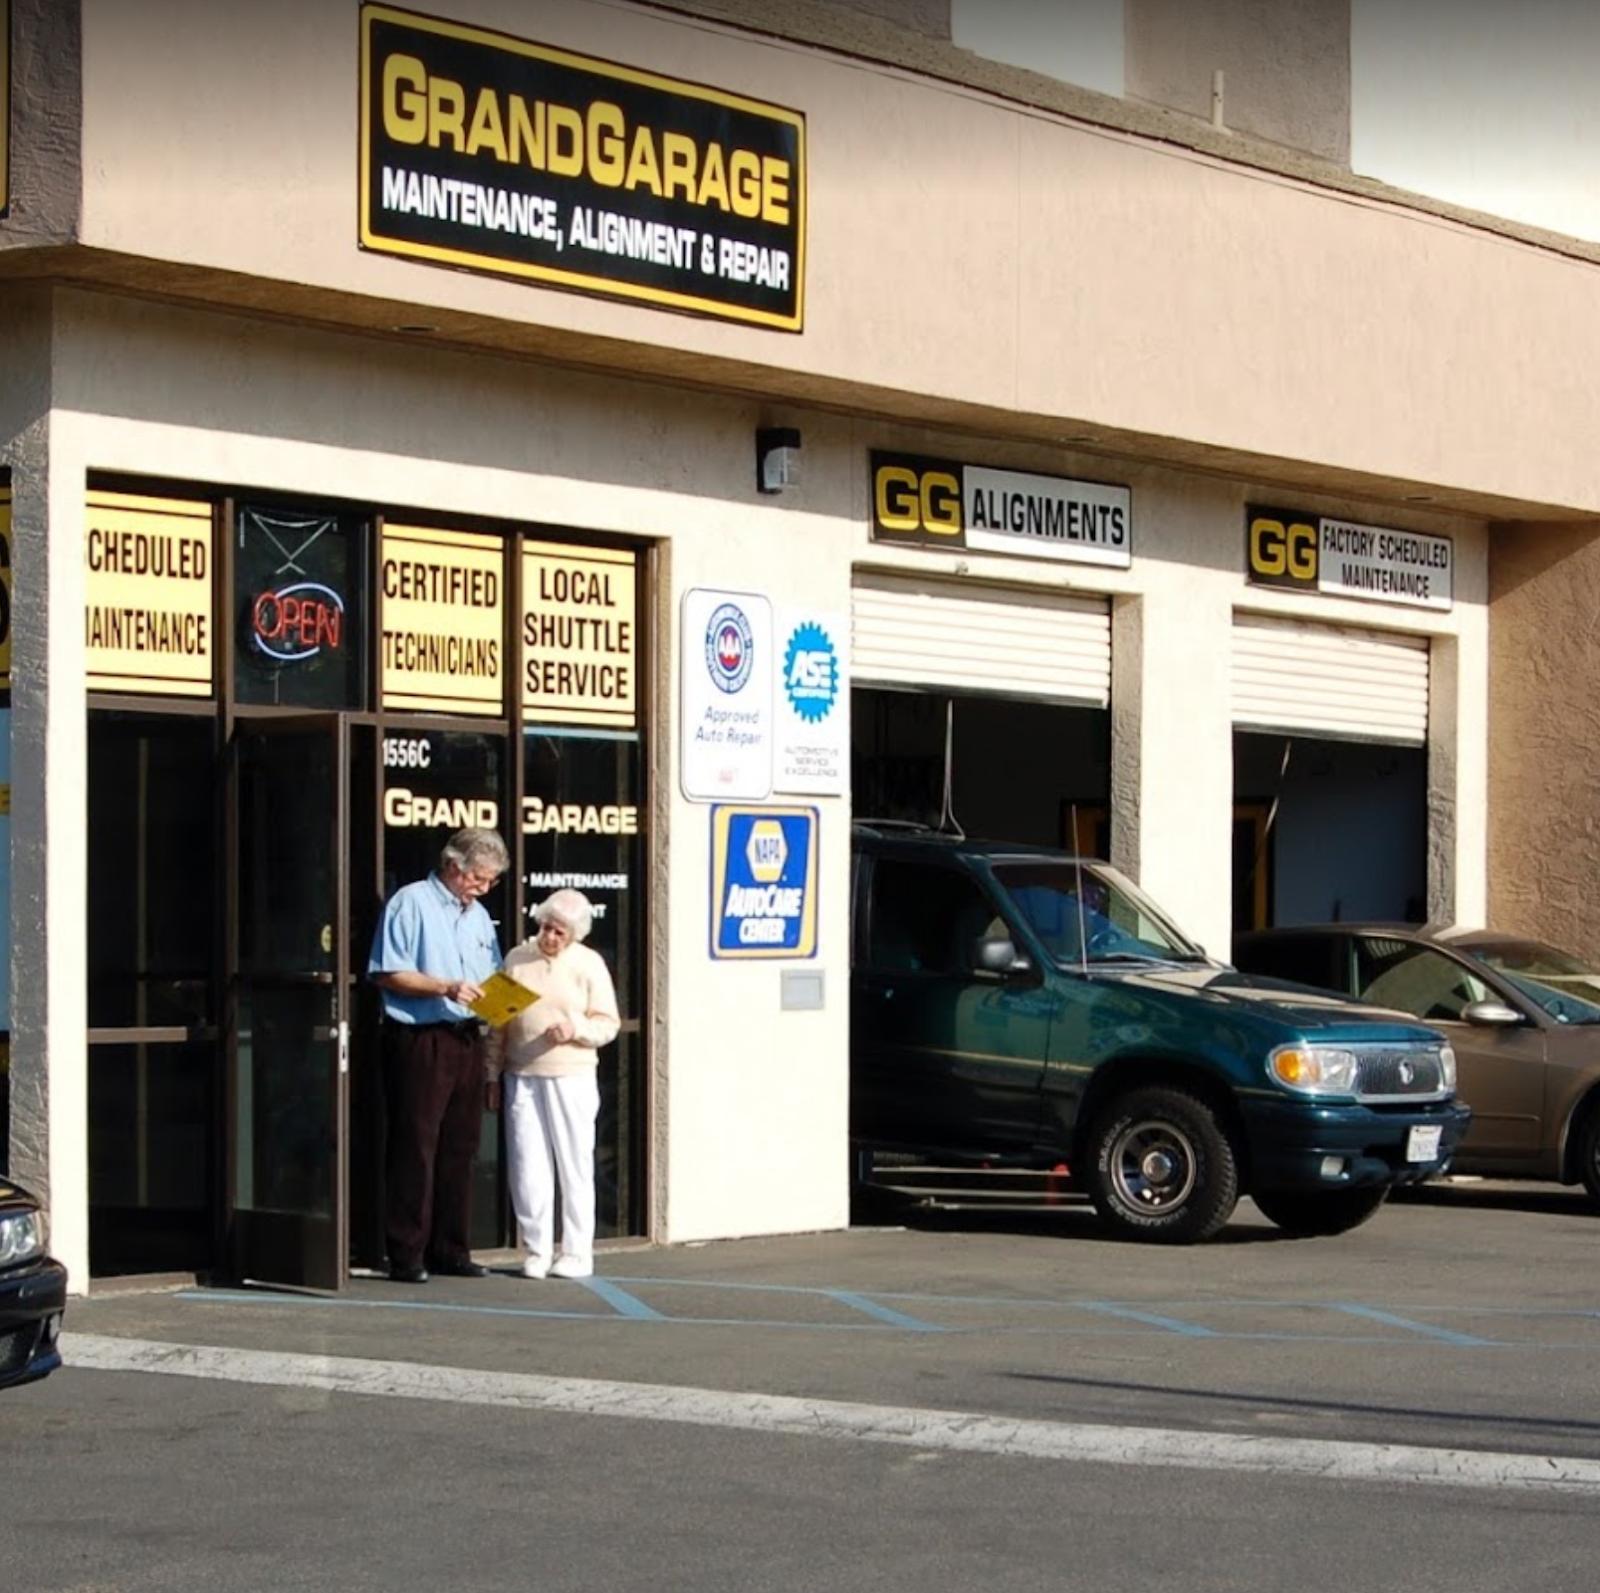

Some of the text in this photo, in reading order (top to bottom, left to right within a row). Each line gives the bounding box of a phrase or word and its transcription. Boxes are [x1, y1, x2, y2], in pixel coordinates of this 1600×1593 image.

[382, 166, 790, 291] MAINTENANCE, ALIGNMENT & REPAIR
[875, 466, 961, 535] GG
[972, 488, 1125, 545] ALIGNMENTS
[85, 528, 206, 581] CHEDULED
[1251, 518, 1317, 580] GG
[1323, 525, 1448, 569] FACTORY SCHEDULED
[382, 559, 498, 608] CERTIFIED
[540, 566, 616, 607] LOCAL
[1341, 562, 1430, 599] MAINTENANCE
[254, 592, 342, 648] OPEN
[524, 612, 630, 654] SHUTTLE
[382, 630, 498, 679] TECHNICIANS
[789, 649, 832, 688] ASE
[526, 659, 628, 700] SERVICE
[704, 704, 760, 725] Approved
[382, 738, 431, 768] 1556C
[695, 725, 763, 748] Auto Repair
[384, 787, 637, 835] GRAND GARAGE
[754, 838, 781, 864] NAPA
[530, 872, 629, 889] MAINTENANCE
[738, 917, 787, 944] CENTER
